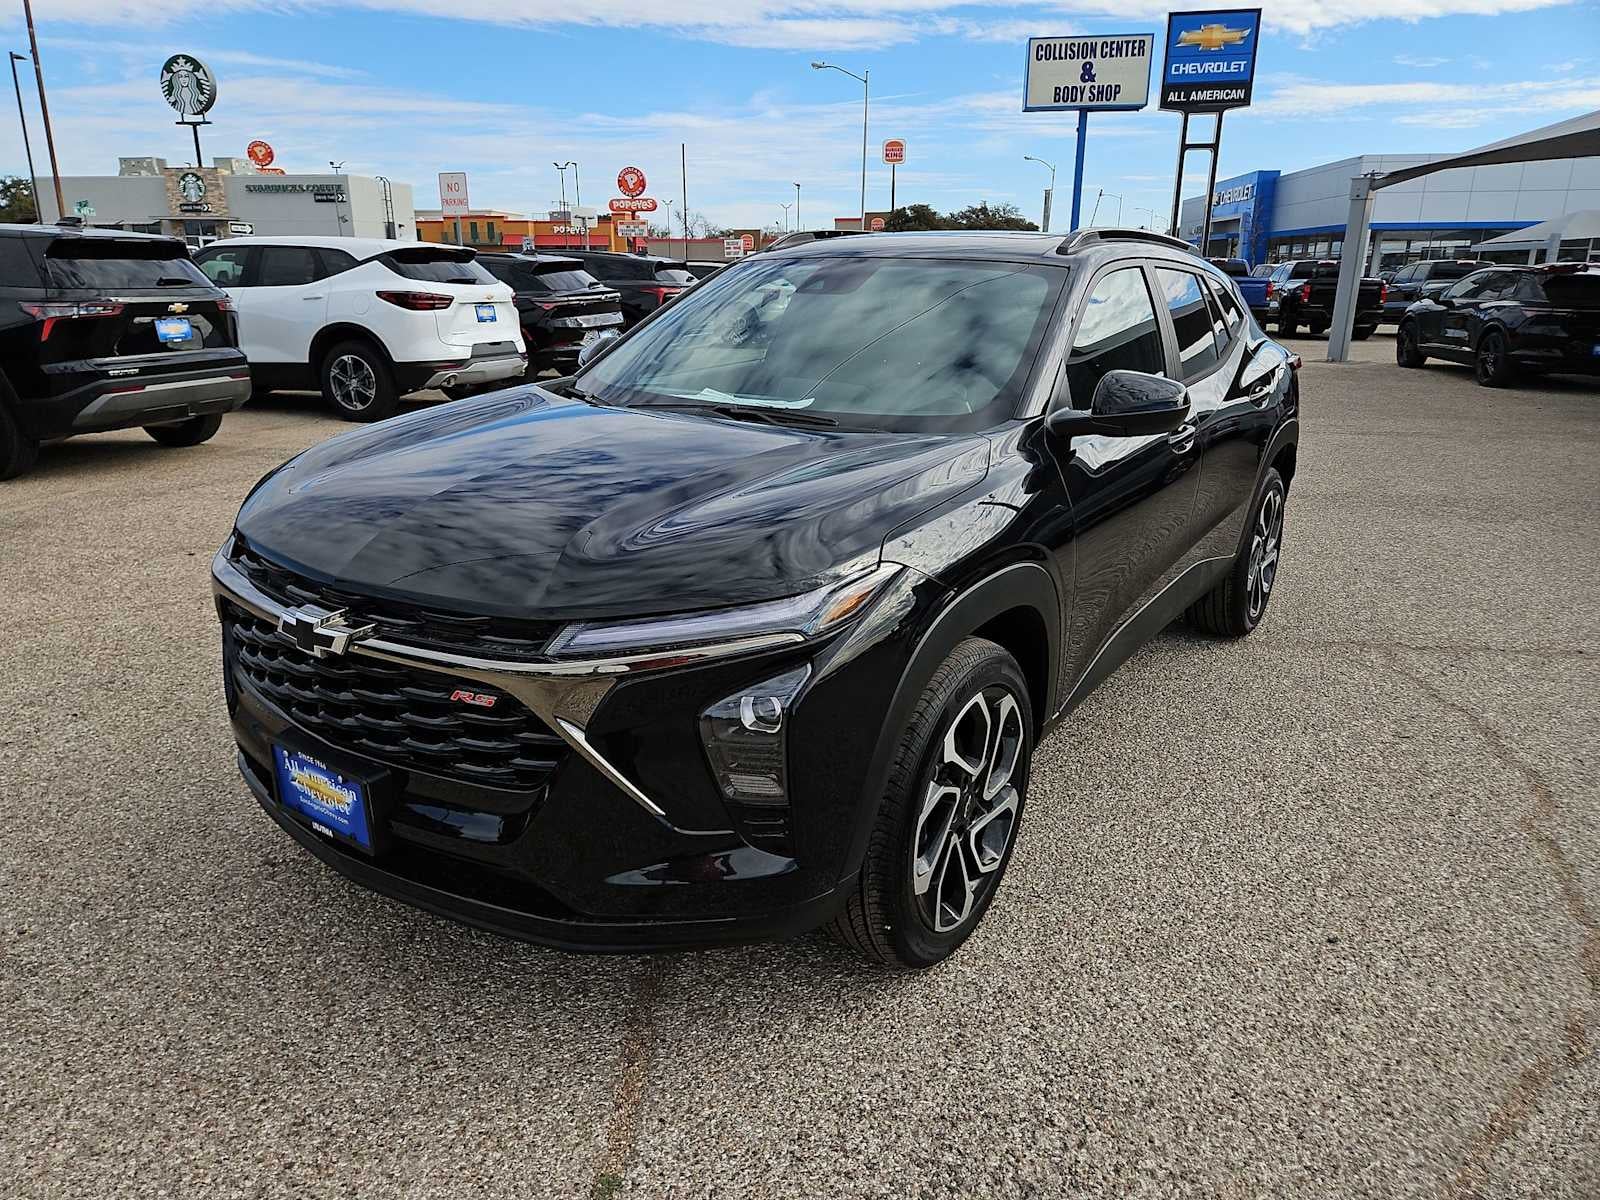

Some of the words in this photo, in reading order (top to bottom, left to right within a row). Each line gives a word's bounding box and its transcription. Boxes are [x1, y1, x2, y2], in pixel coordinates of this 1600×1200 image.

[1036, 41, 1098, 61] COLLISION
[1100, 39, 1146, 59] CENTER
[1080, 61, 1096, 83] &
[1171, 61, 1247, 75] CHEVROLET
[1053, 85, 1086, 103] BODY
[1088, 84, 1121, 102] SHOP
[1167, 91, 1187, 102] ALL
[1189, 89, 1245, 101] AMERICAN
[245, 184, 305, 193] STARBUCKS
[447, 182, 460, 193] NO
[442, 198, 468, 208] PARKING
[611, 199, 653, 210] POPEYES
[450, 690, 497, 707] RS
[284, 758, 299, 772] All
